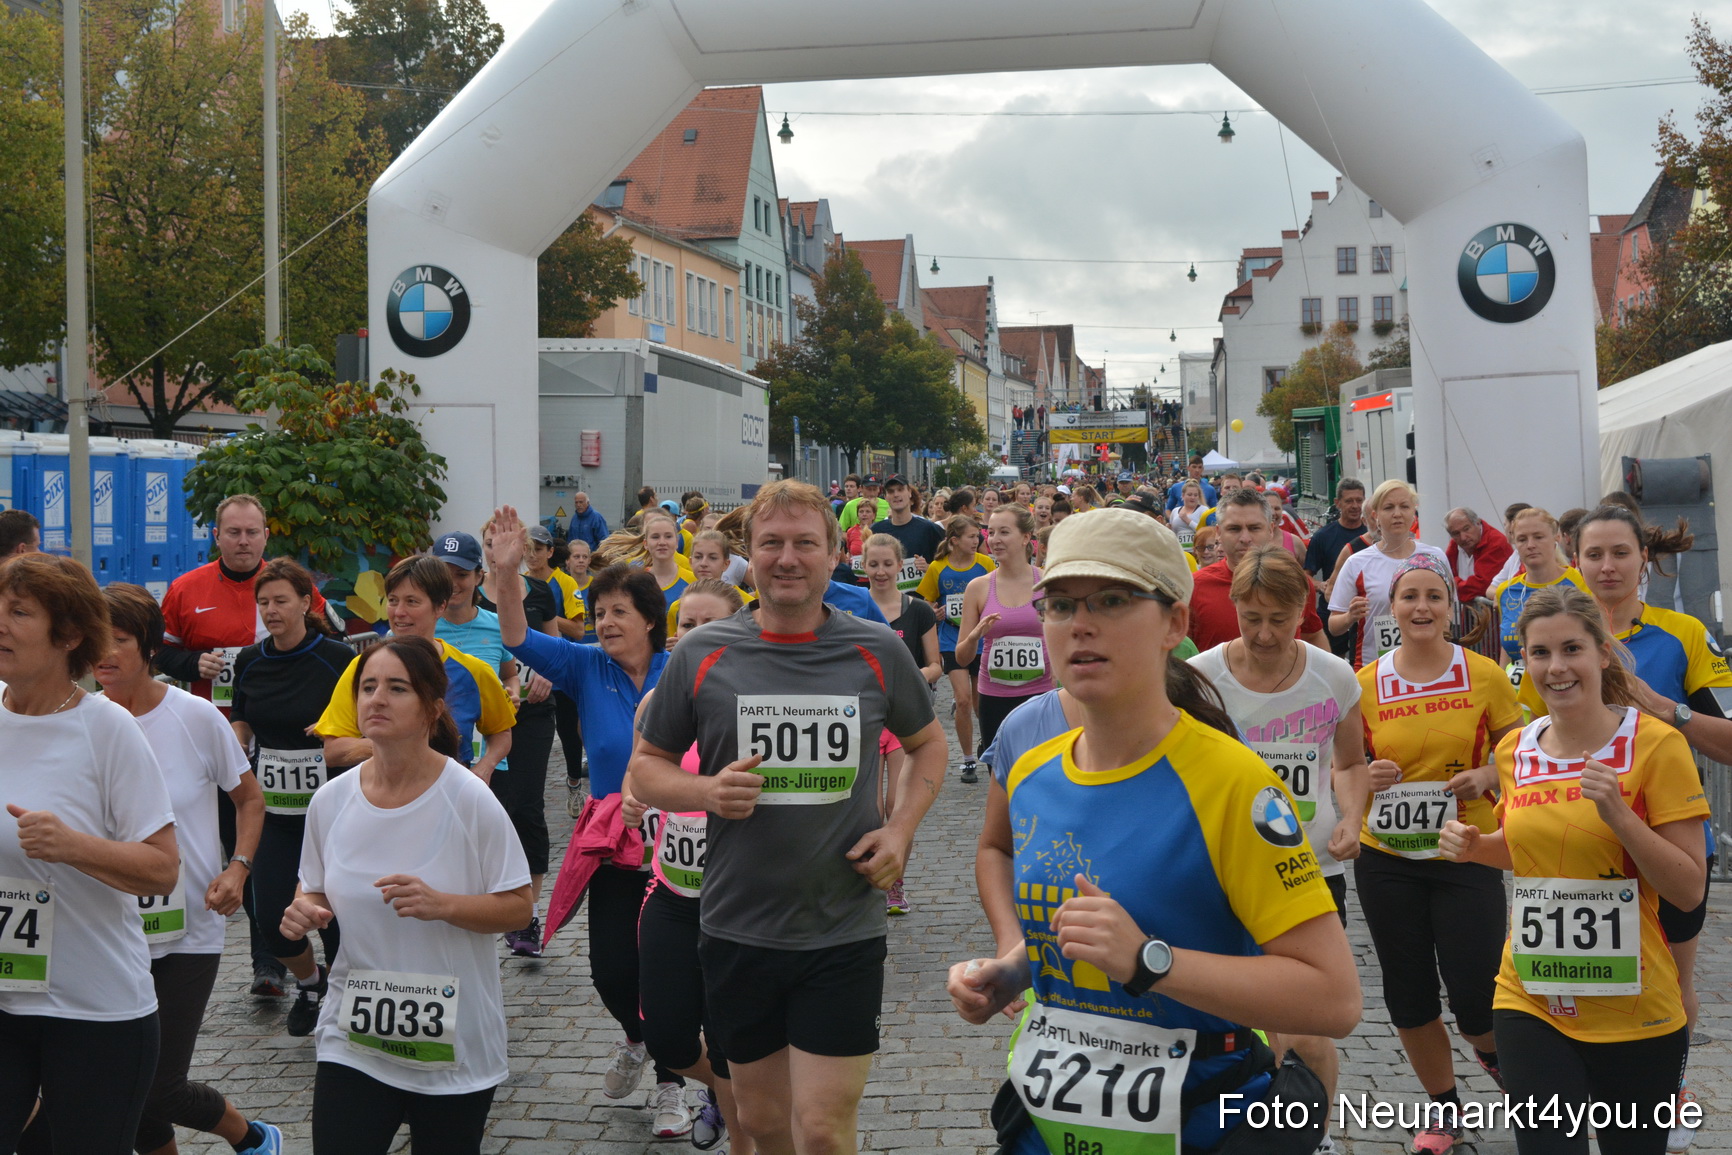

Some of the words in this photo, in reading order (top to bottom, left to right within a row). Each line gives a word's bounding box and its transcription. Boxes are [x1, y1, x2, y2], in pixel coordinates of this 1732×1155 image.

[1465, 225, 1548, 260] BMW
[391, 267, 463, 297] BMW
[1081, 431, 1115, 440] START
[994, 649, 1039, 667] 5169
[1010, 672, 1023, 680] Lea
[740, 706, 779, 716] PARTL
[783, 706, 839, 716] Neumarkt
[1379, 704, 1419, 722] MAX
[1425, 698, 1474, 714] BÖGL
[751, 722, 849, 762] 5019
[260, 753, 280, 762] PARTL
[280, 756, 312, 764] Neumarkt
[264, 765, 319, 790] 5115
[760, 773, 846, 791] ans-Jürgen
[273, 795, 309, 806] Gislinde
[1375, 792, 1400, 801] PARTL
[1401, 789, 1441, 798] Neumarkt
[1511, 788, 1558, 810] MAX
[1377, 801, 1448, 830] 5047
[1388, 837, 1437, 849] Christine
[1515, 888, 1549, 900] PARTL
[1552, 890, 1614, 900] Neumarkt
[1521, 906, 1621, 950] 5131
[1532, 960, 1613, 979] Katharina
[347, 980, 381, 991] PARTL
[384, 982, 438, 996] Neumarkt
[350, 996, 445, 1037] 5033
[1027, 1019, 1076, 1044] PARTL
[1079, 1030, 1160, 1058] Neumarkt
[381, 1040, 416, 1057] Anita
[1023, 1049, 1165, 1122] 5210
[1064, 1132, 1103, 1155] Bea
